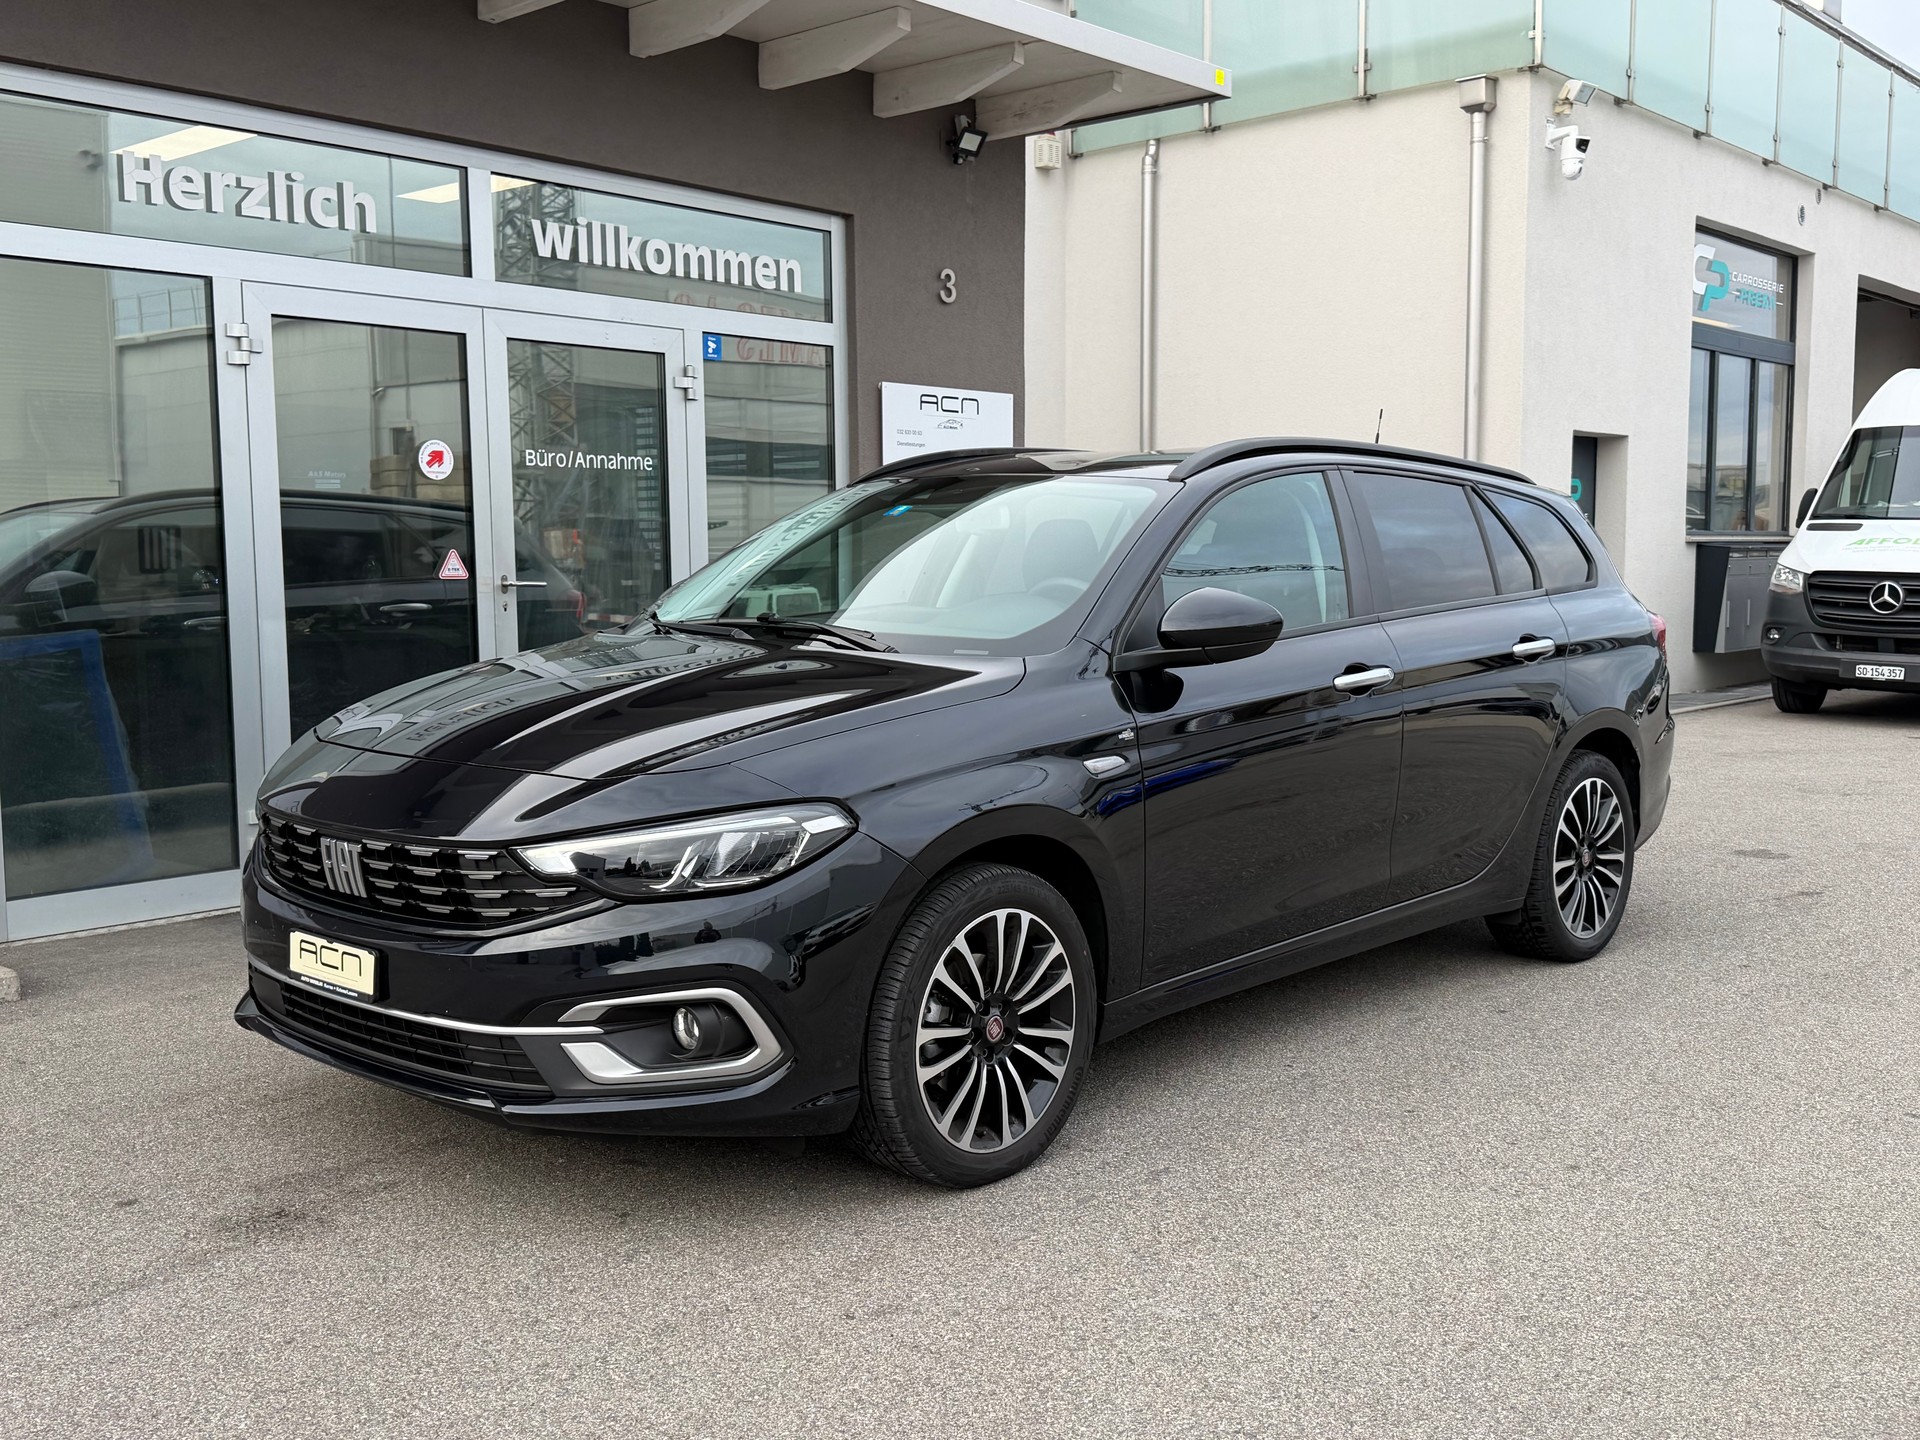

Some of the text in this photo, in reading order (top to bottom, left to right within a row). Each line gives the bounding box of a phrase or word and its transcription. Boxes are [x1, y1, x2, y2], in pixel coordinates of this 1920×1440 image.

[119, 149, 802, 293] Herzlich willkommen
[939, 268, 957, 304] 3
[1731, 271, 1784, 293] CARROSSERIE
[525, 449, 653, 471] Büro/Annahme
[320, 837, 368, 898] FIAT
